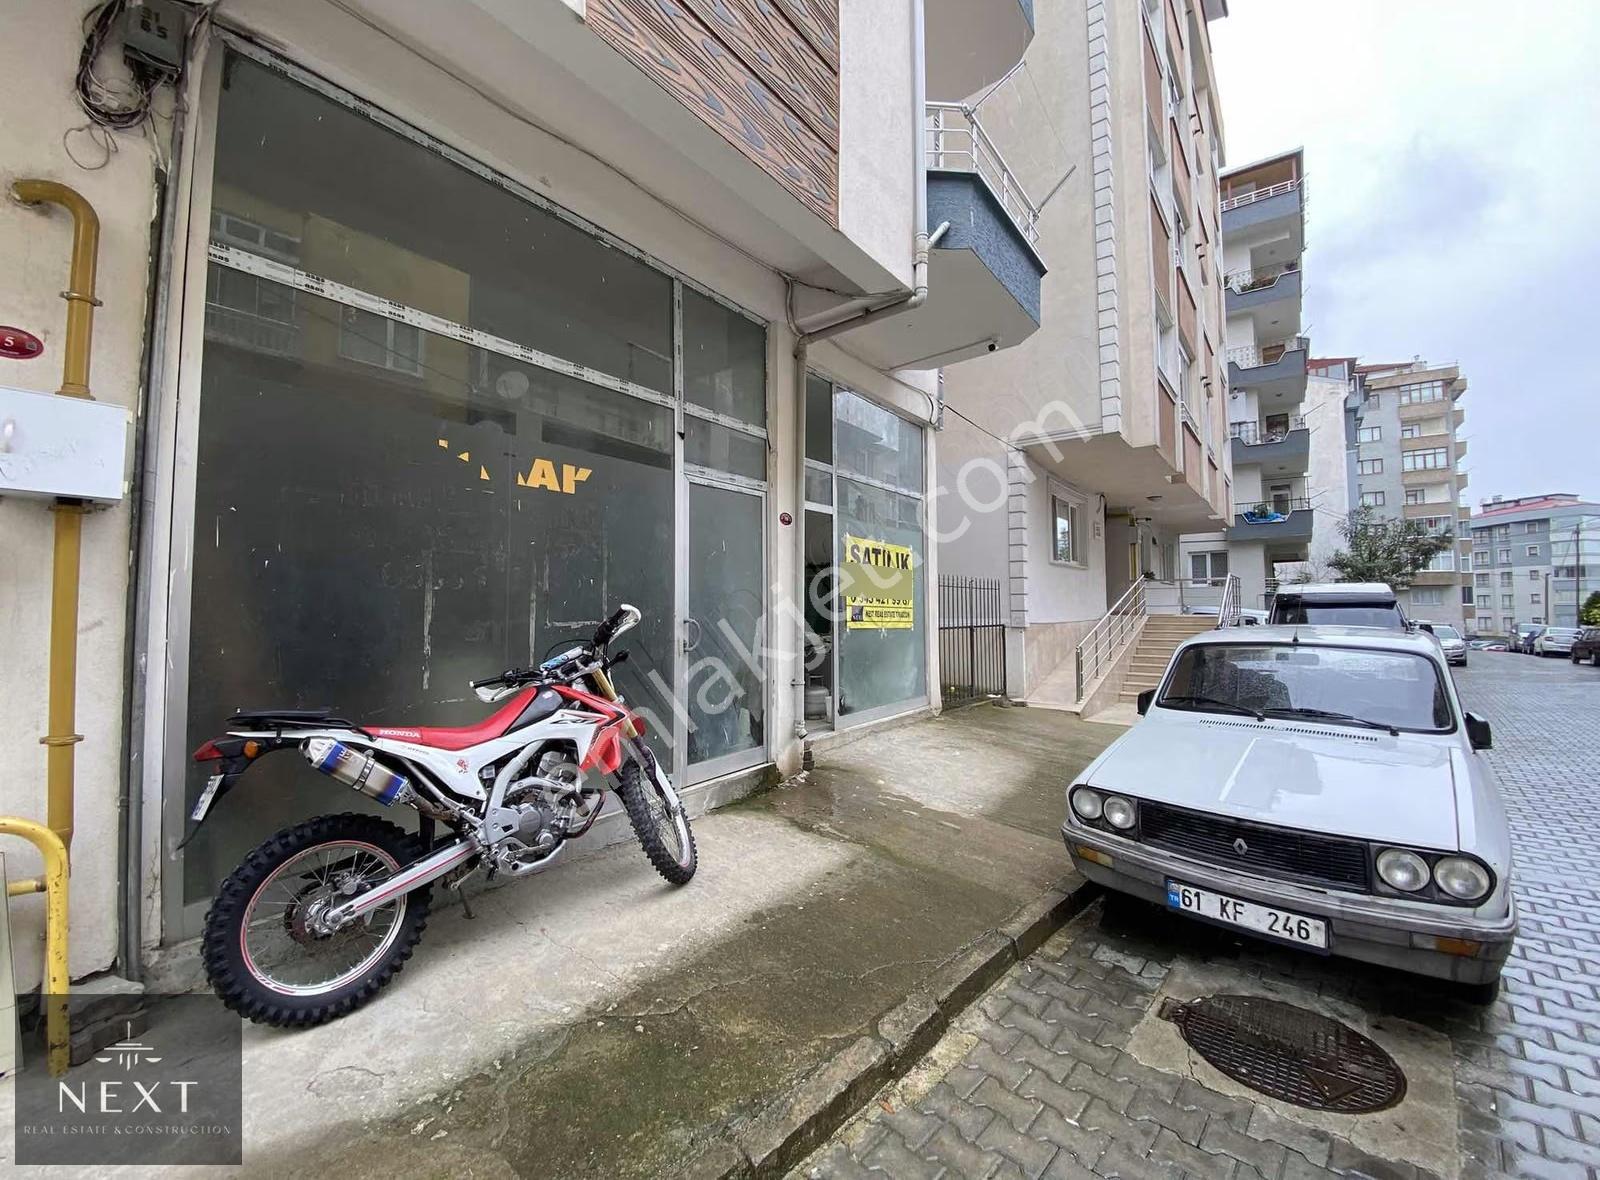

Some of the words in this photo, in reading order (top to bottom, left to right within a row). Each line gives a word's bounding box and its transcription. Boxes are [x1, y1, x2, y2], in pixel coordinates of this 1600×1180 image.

[4, 336, 15, 347] 5
[379, 729, 421, 739] HONDA
[1181, 888, 1202, 911] 61
[1219, 898, 1245, 922] KF
[1268, 912, 1311, 941] 246
